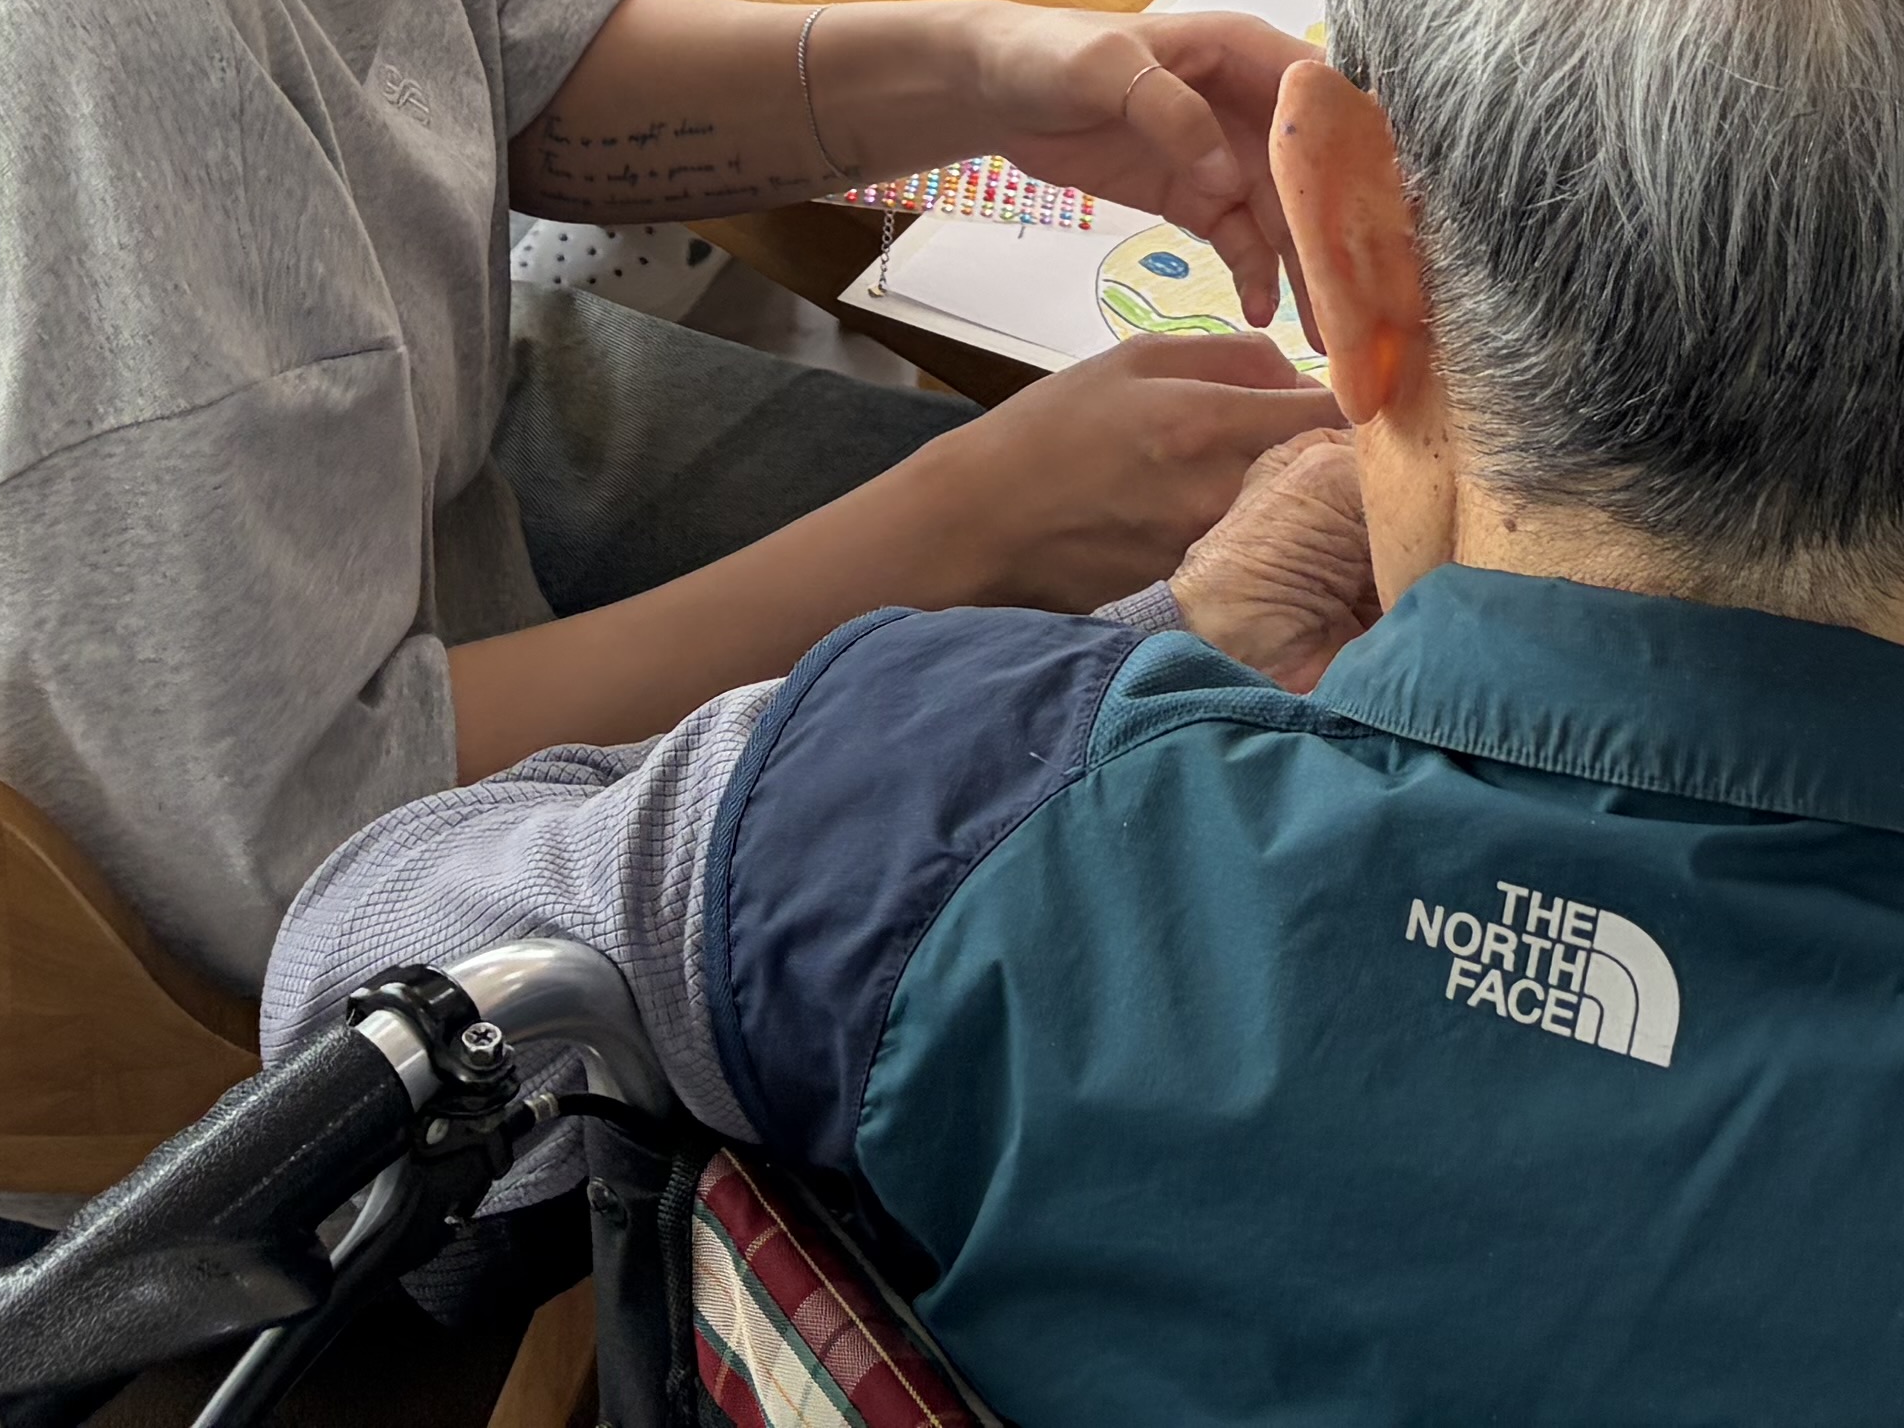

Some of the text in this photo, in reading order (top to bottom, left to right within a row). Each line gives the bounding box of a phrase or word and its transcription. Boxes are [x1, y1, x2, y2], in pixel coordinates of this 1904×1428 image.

[1404, 897, 1590, 994] NORTH
[1496, 880, 1597, 950] THE
[1445, 956, 1579, 1038] FACE
